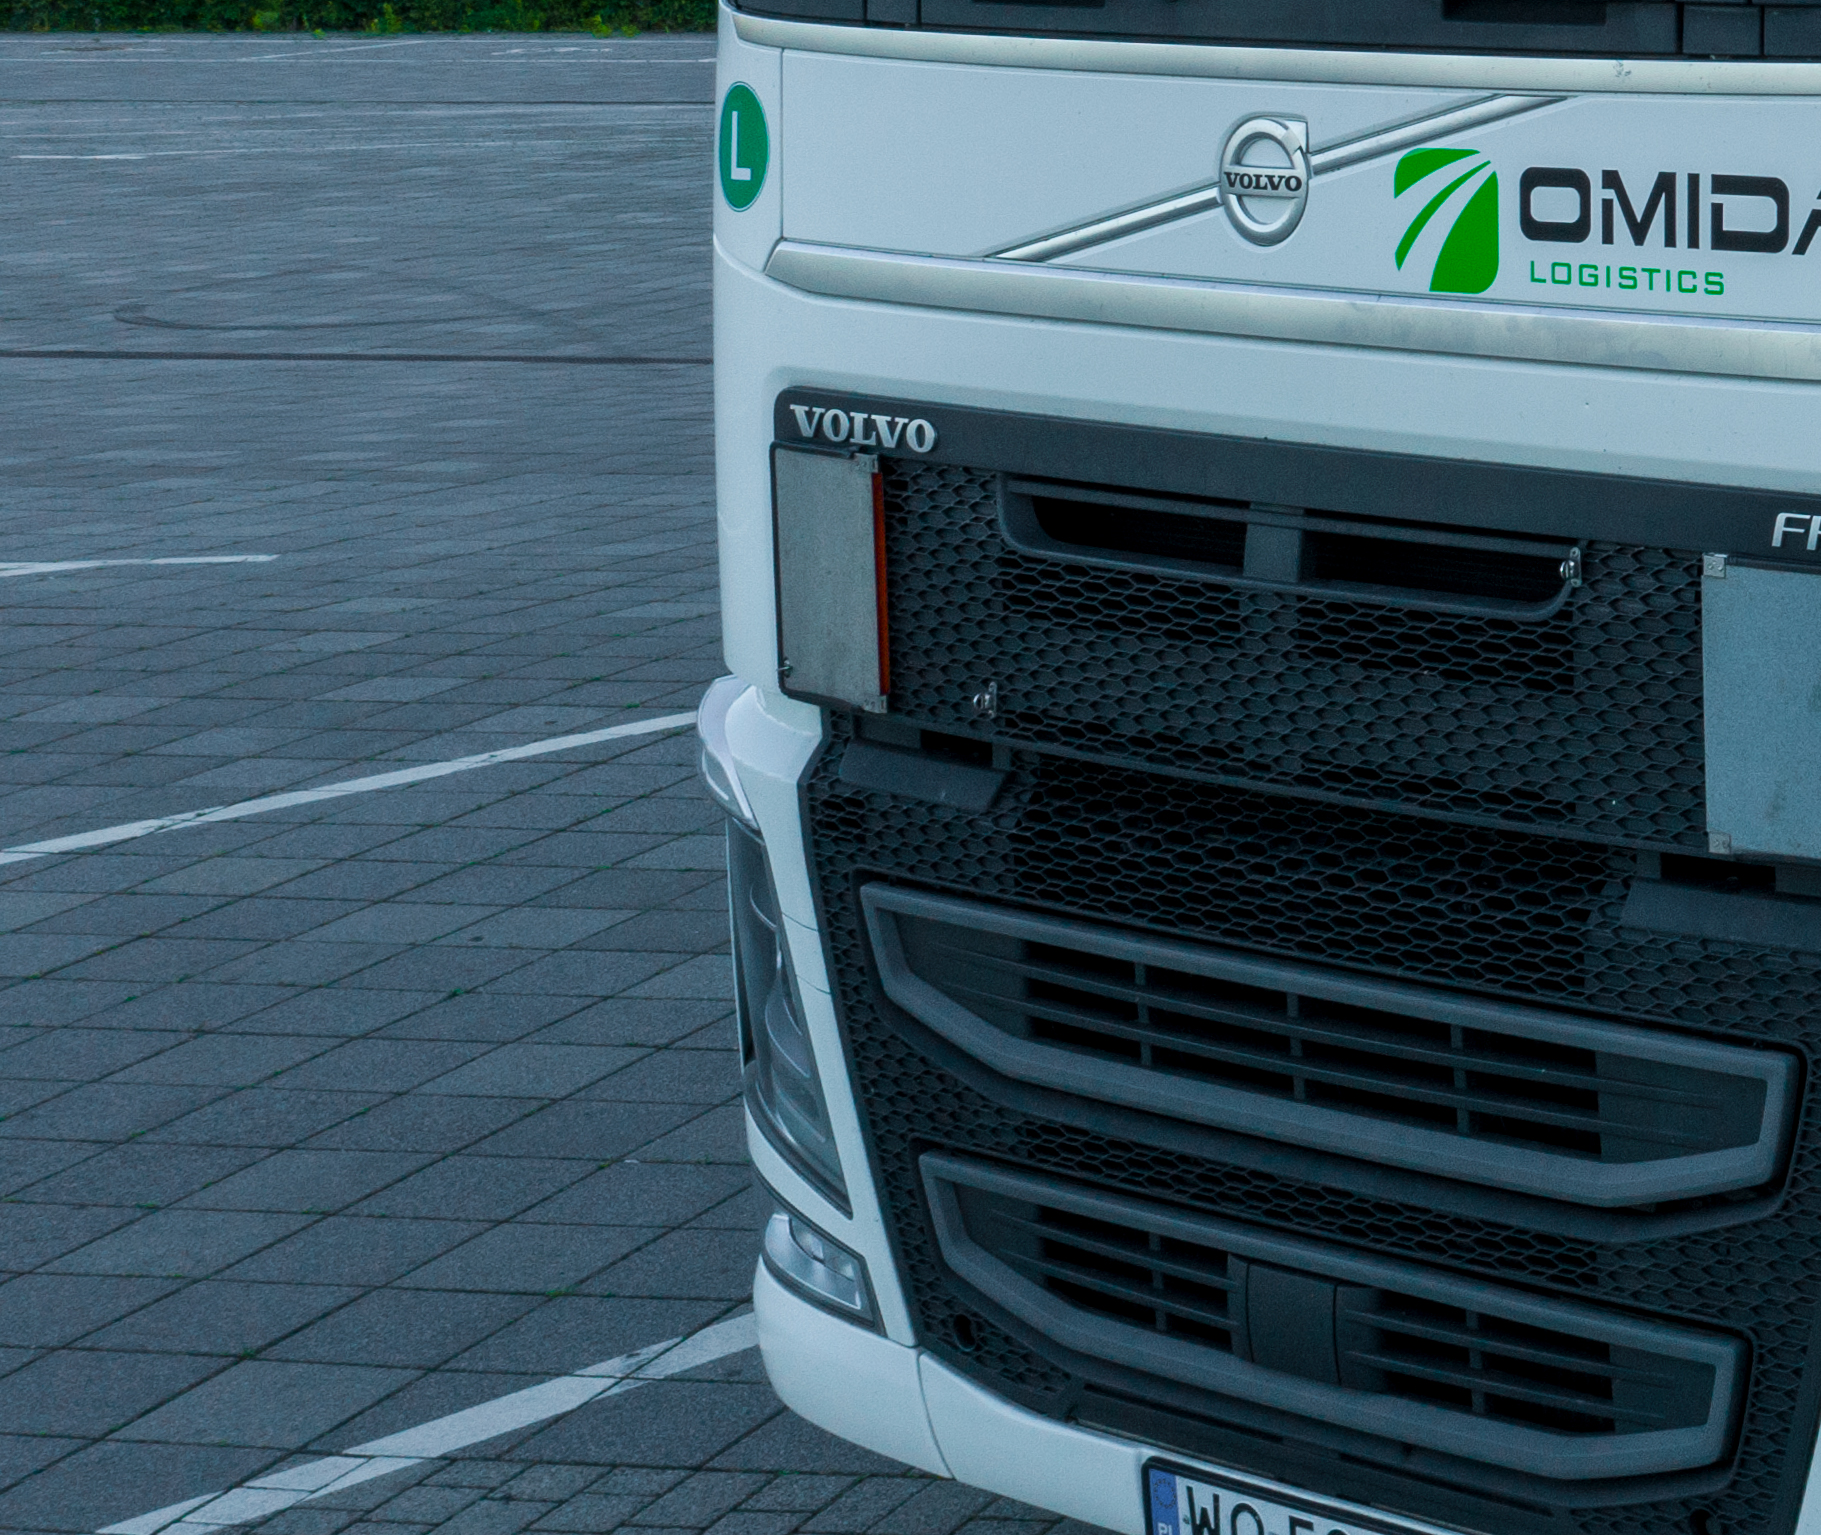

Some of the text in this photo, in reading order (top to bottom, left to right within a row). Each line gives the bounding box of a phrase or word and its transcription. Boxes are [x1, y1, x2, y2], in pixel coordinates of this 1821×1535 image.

[730, 110, 751, 181] L
[1223, 170, 1303, 193] VOLVO
[1530, 260, 1725, 296] LOGISTICS
[789, 404, 937, 454] VOLVO
